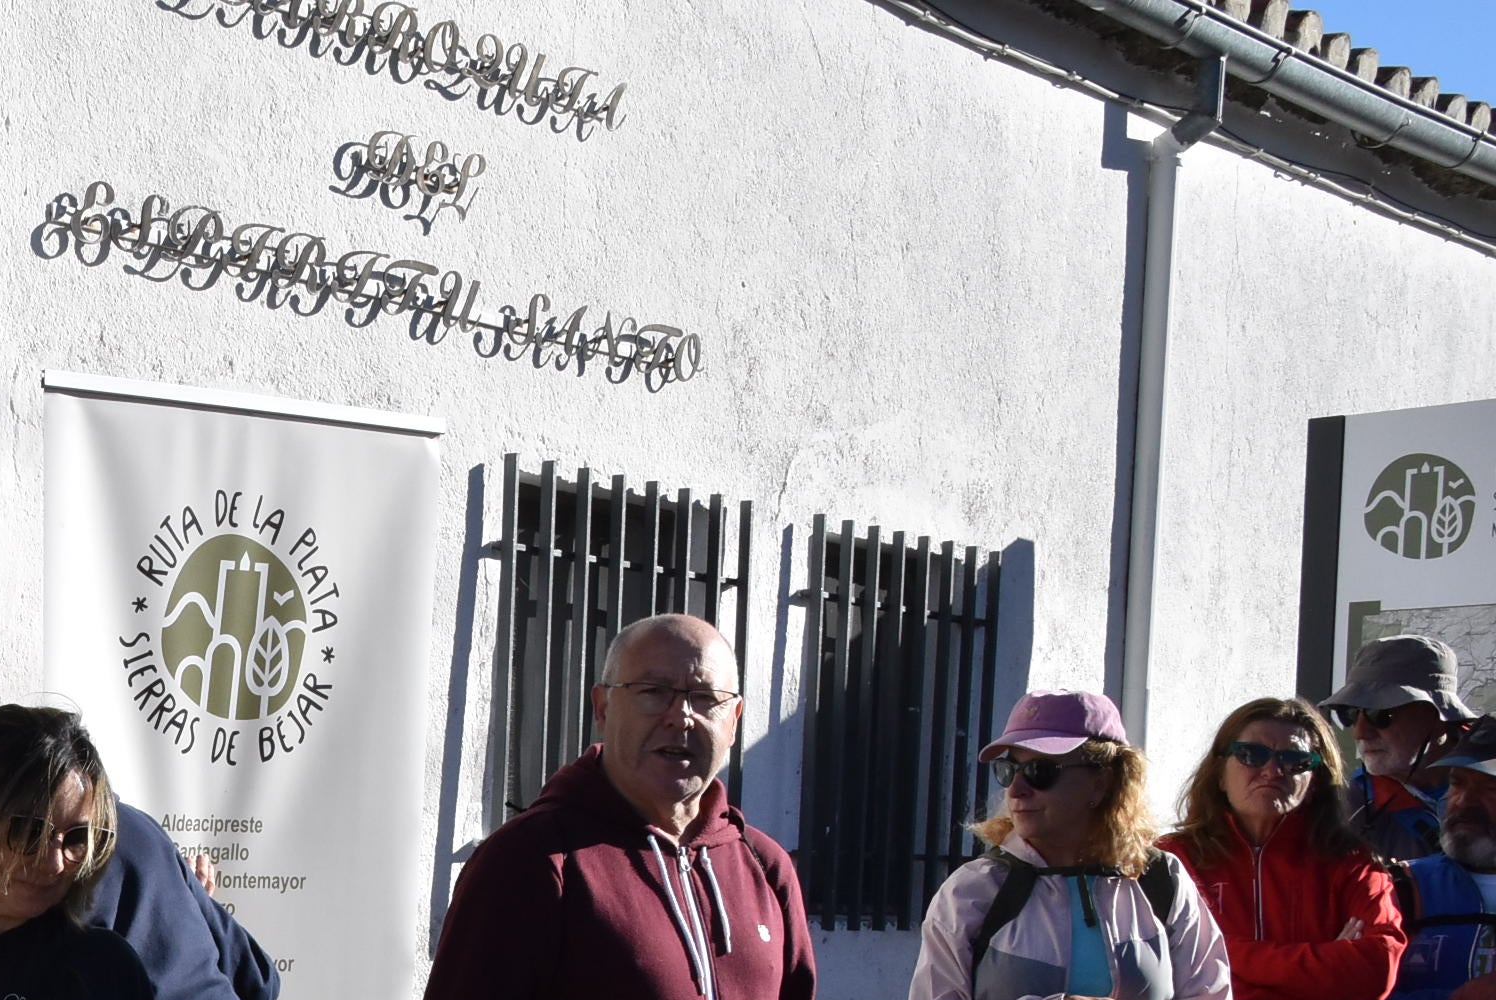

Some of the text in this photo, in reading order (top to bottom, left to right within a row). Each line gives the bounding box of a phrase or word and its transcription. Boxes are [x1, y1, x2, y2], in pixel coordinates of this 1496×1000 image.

[502, 293, 703, 384] SANTO
[136, 489, 340, 633] RUTA DE LA PLATA
[119, 632, 333, 766] SIERRAS DE BÉJAR
[161, 814, 263, 836] Aldeacipreste
